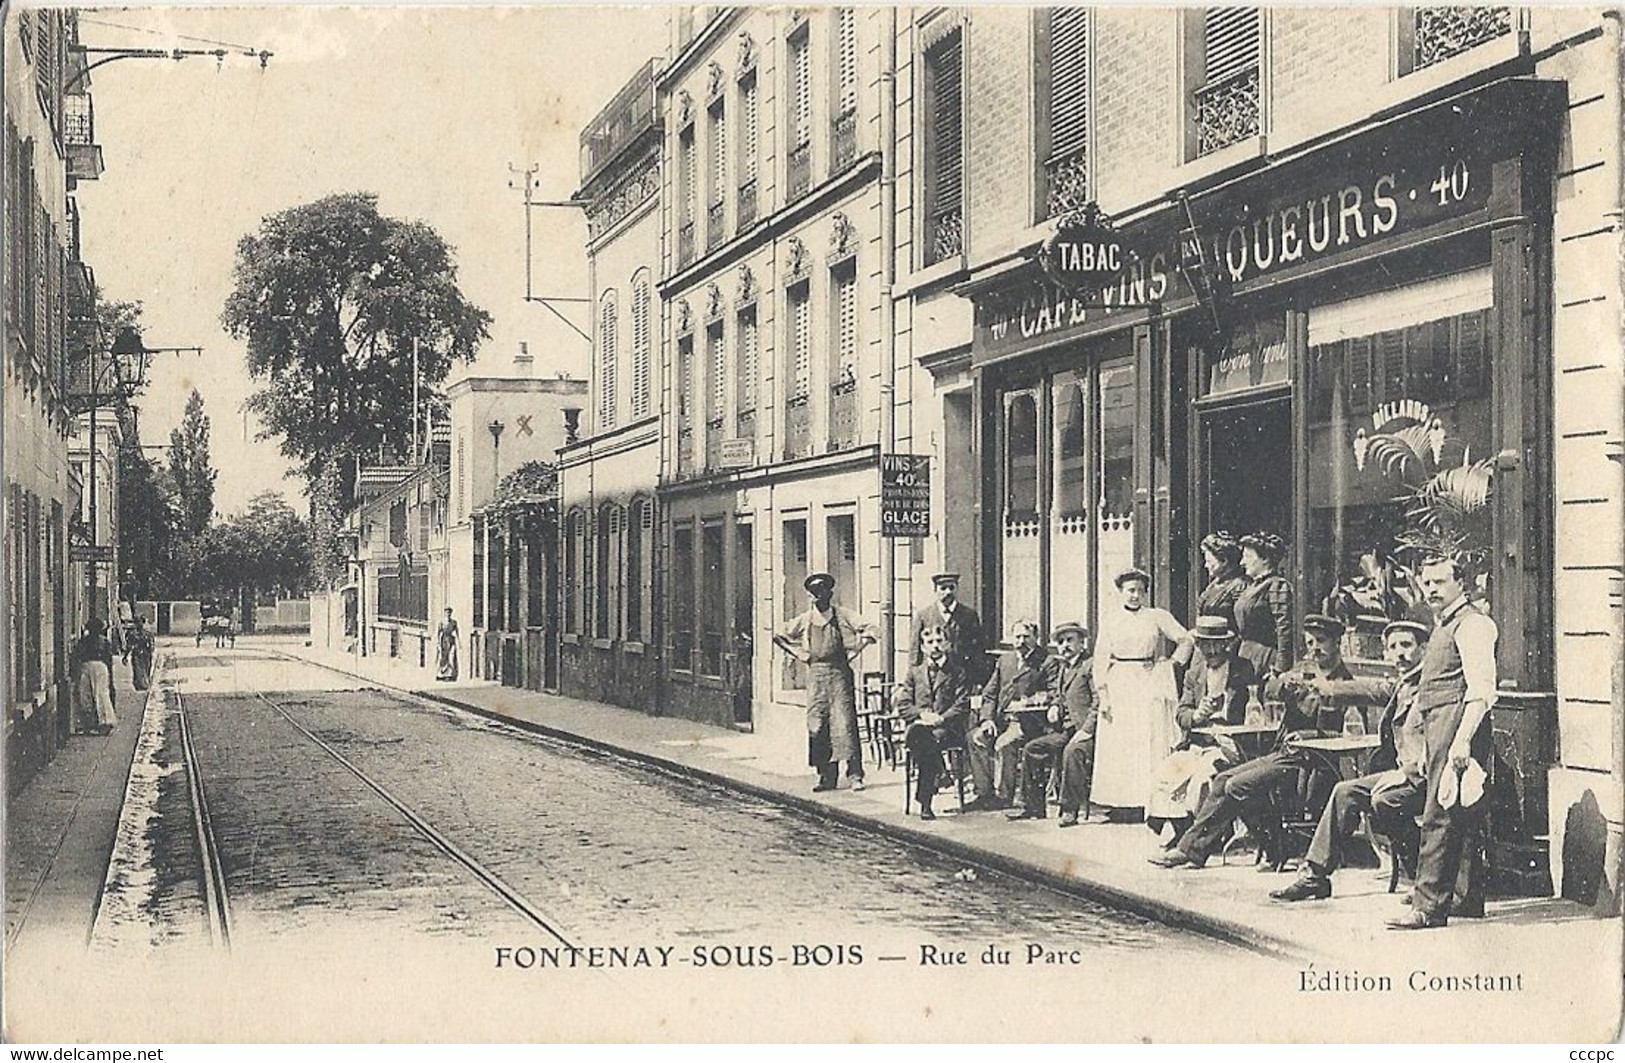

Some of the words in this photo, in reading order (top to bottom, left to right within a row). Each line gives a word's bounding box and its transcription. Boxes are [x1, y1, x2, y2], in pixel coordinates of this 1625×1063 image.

[1430, 159, 1470, 206] 40
[1058, 242, 1121, 272] TABAC
[883, 456, 911, 472] VINS
[883, 510, 929, 524] GLACE
